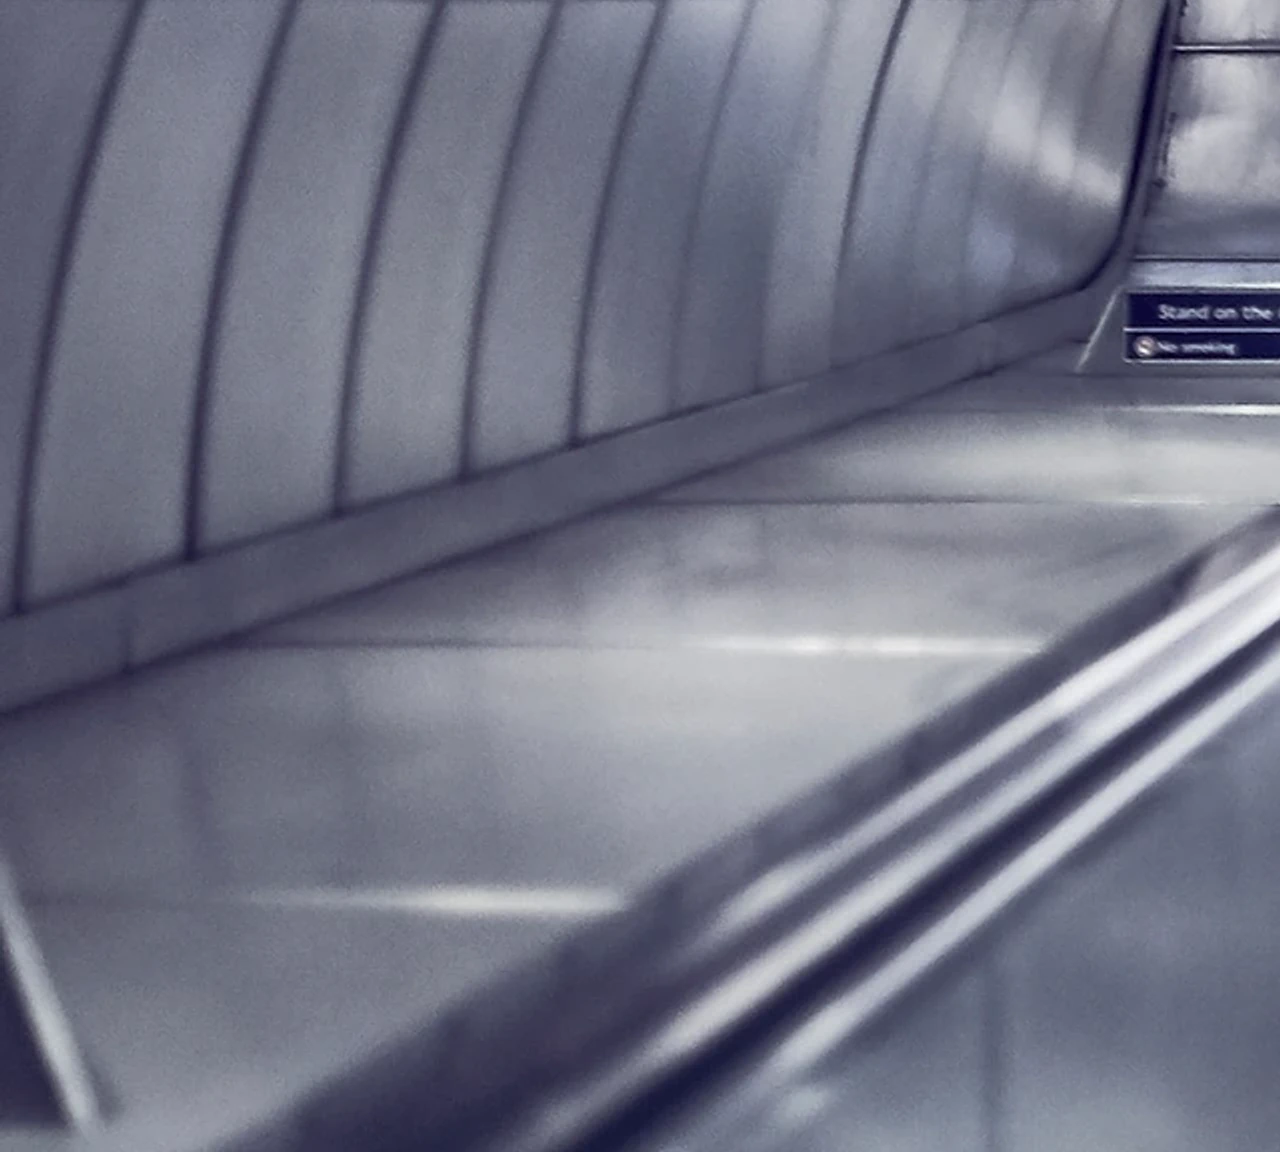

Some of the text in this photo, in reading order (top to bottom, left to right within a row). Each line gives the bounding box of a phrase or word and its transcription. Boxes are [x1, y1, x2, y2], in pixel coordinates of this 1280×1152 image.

[1158, 304, 1209, 320] Stand
[1214, 308, 1236, 320] on
[1242, 305, 1272, 320] the
[1158, 341, 1236, 355] No smoking
